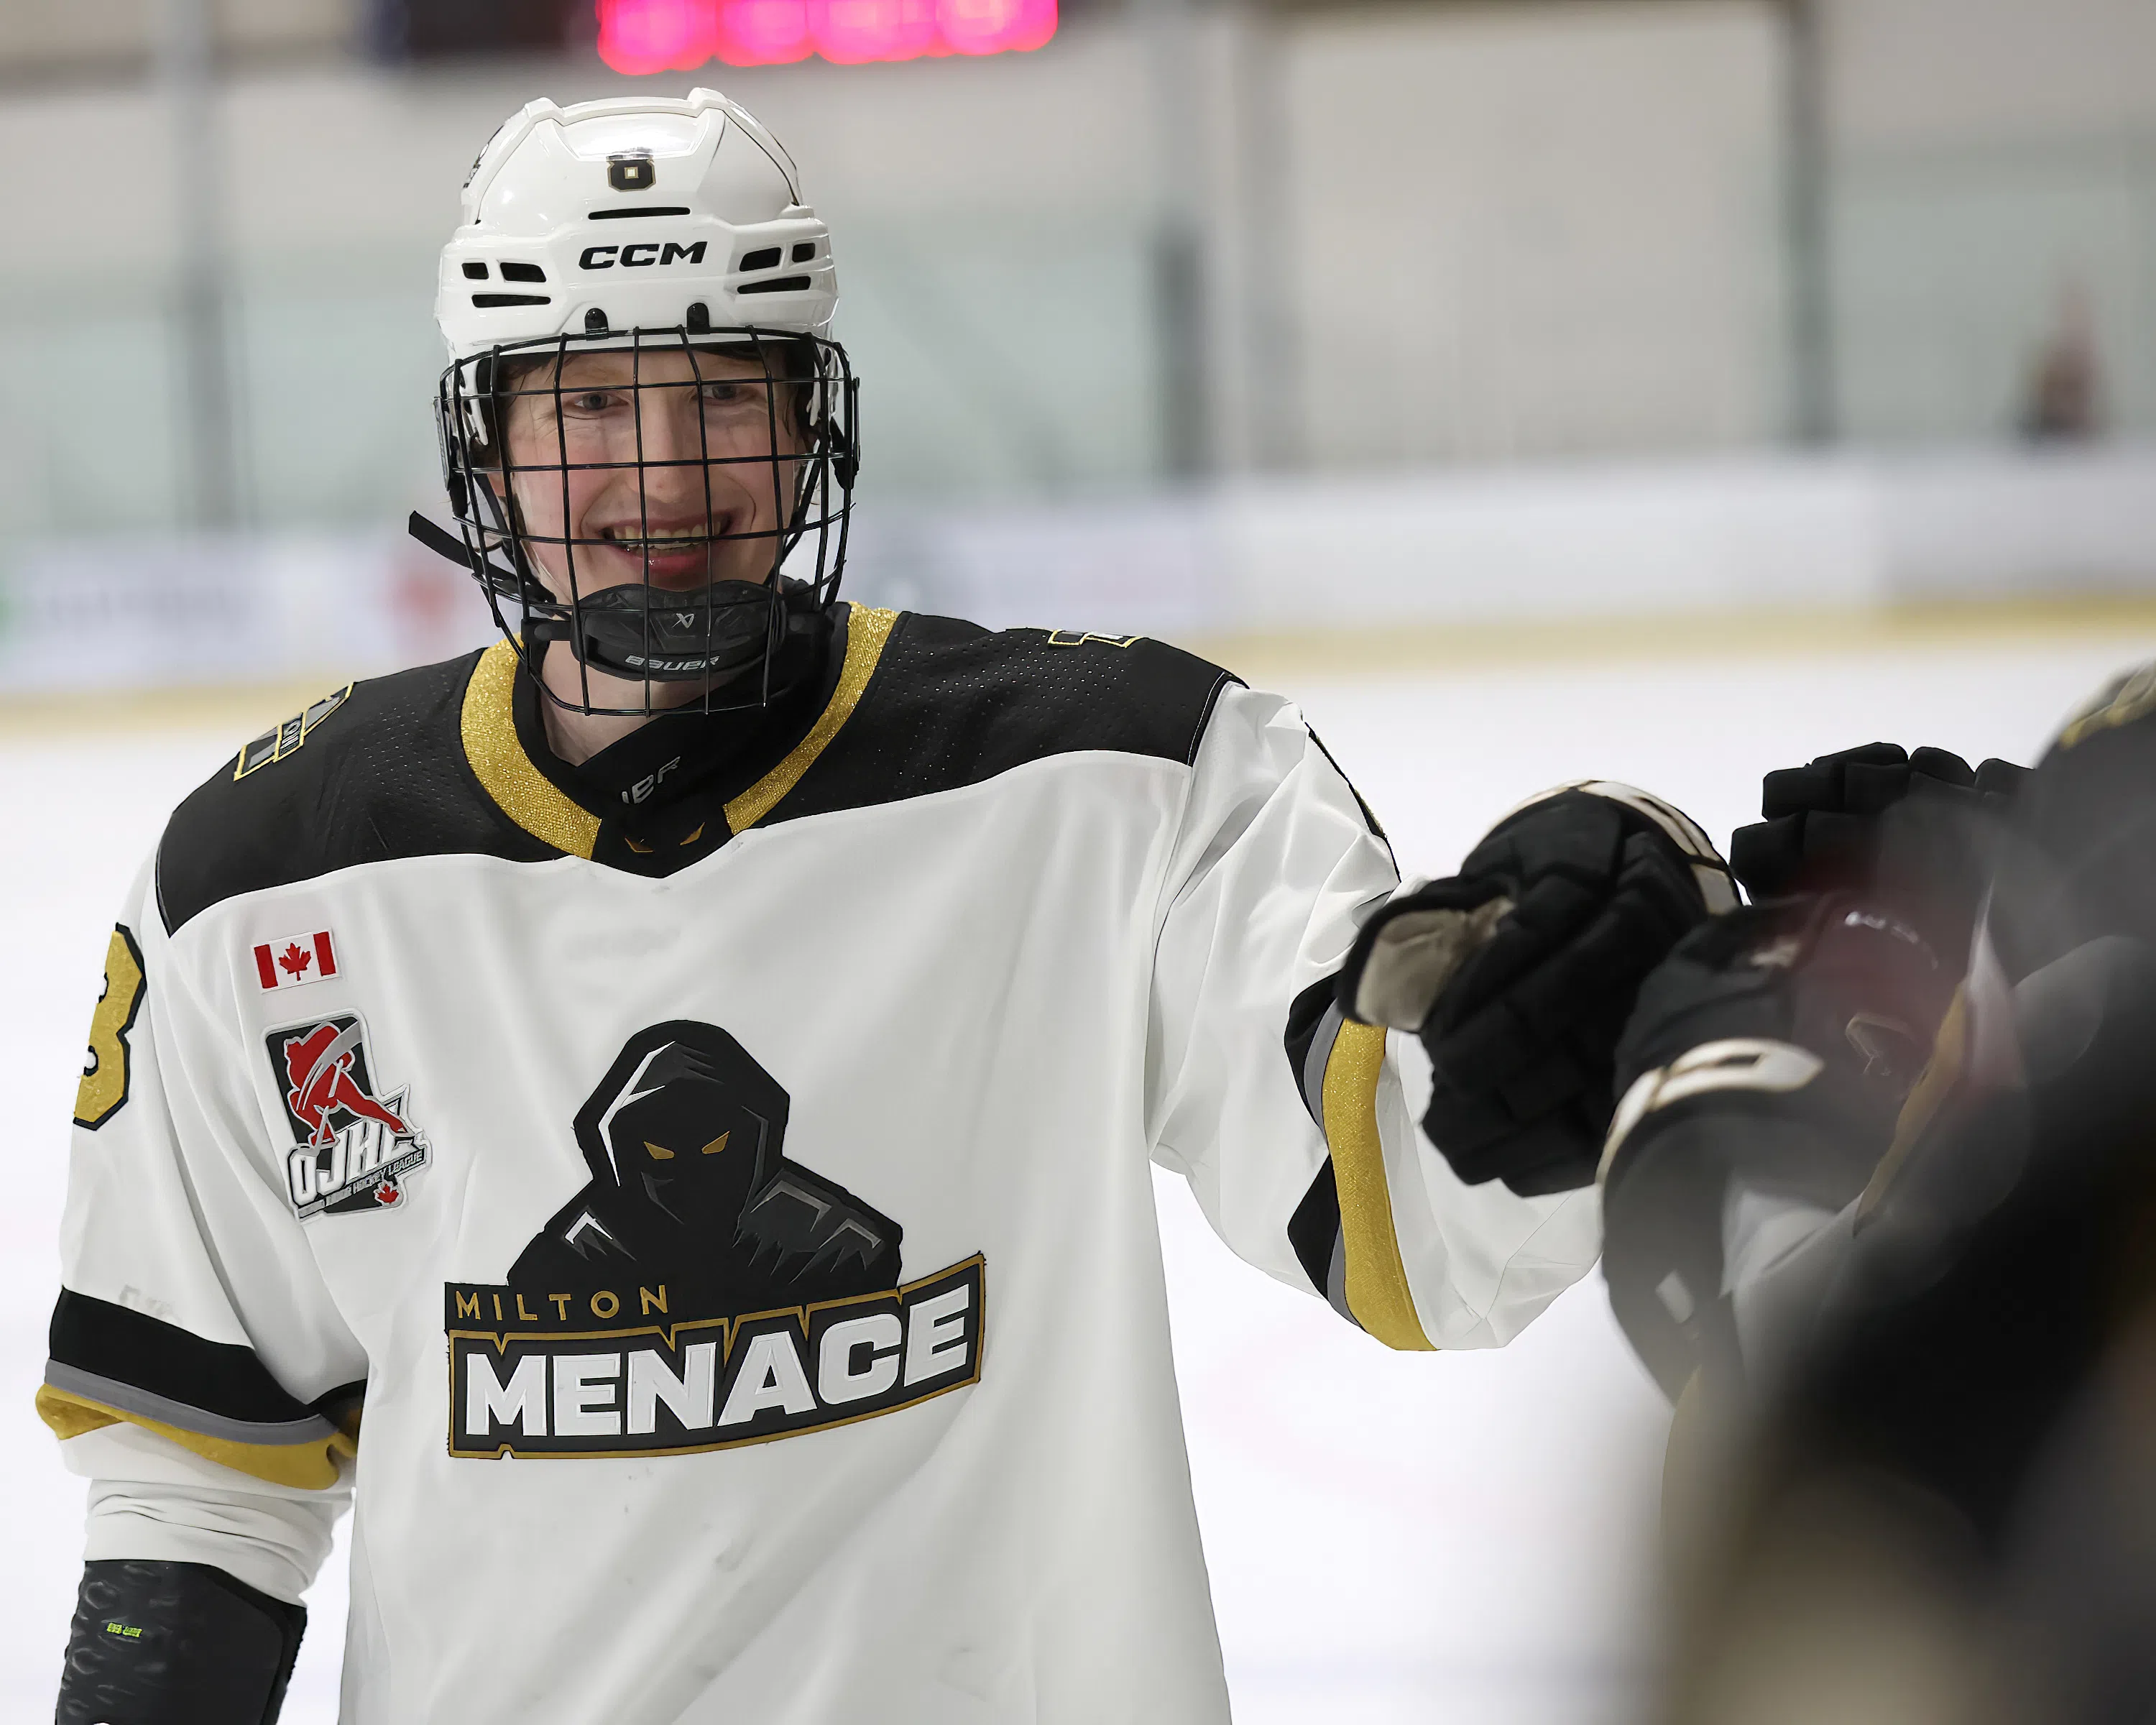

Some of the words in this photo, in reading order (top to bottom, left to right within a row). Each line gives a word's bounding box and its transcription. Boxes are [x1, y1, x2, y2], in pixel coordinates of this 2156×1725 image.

[579, 241, 708, 270] CCM
[624, 654, 720, 671] BAUER
[289, 1117, 422, 1207] OJHL
[388, 1149, 423, 1177] LEAGUE
[454, 1284, 668, 1321] MILTON
[465, 1284, 969, 1437] MENACE
